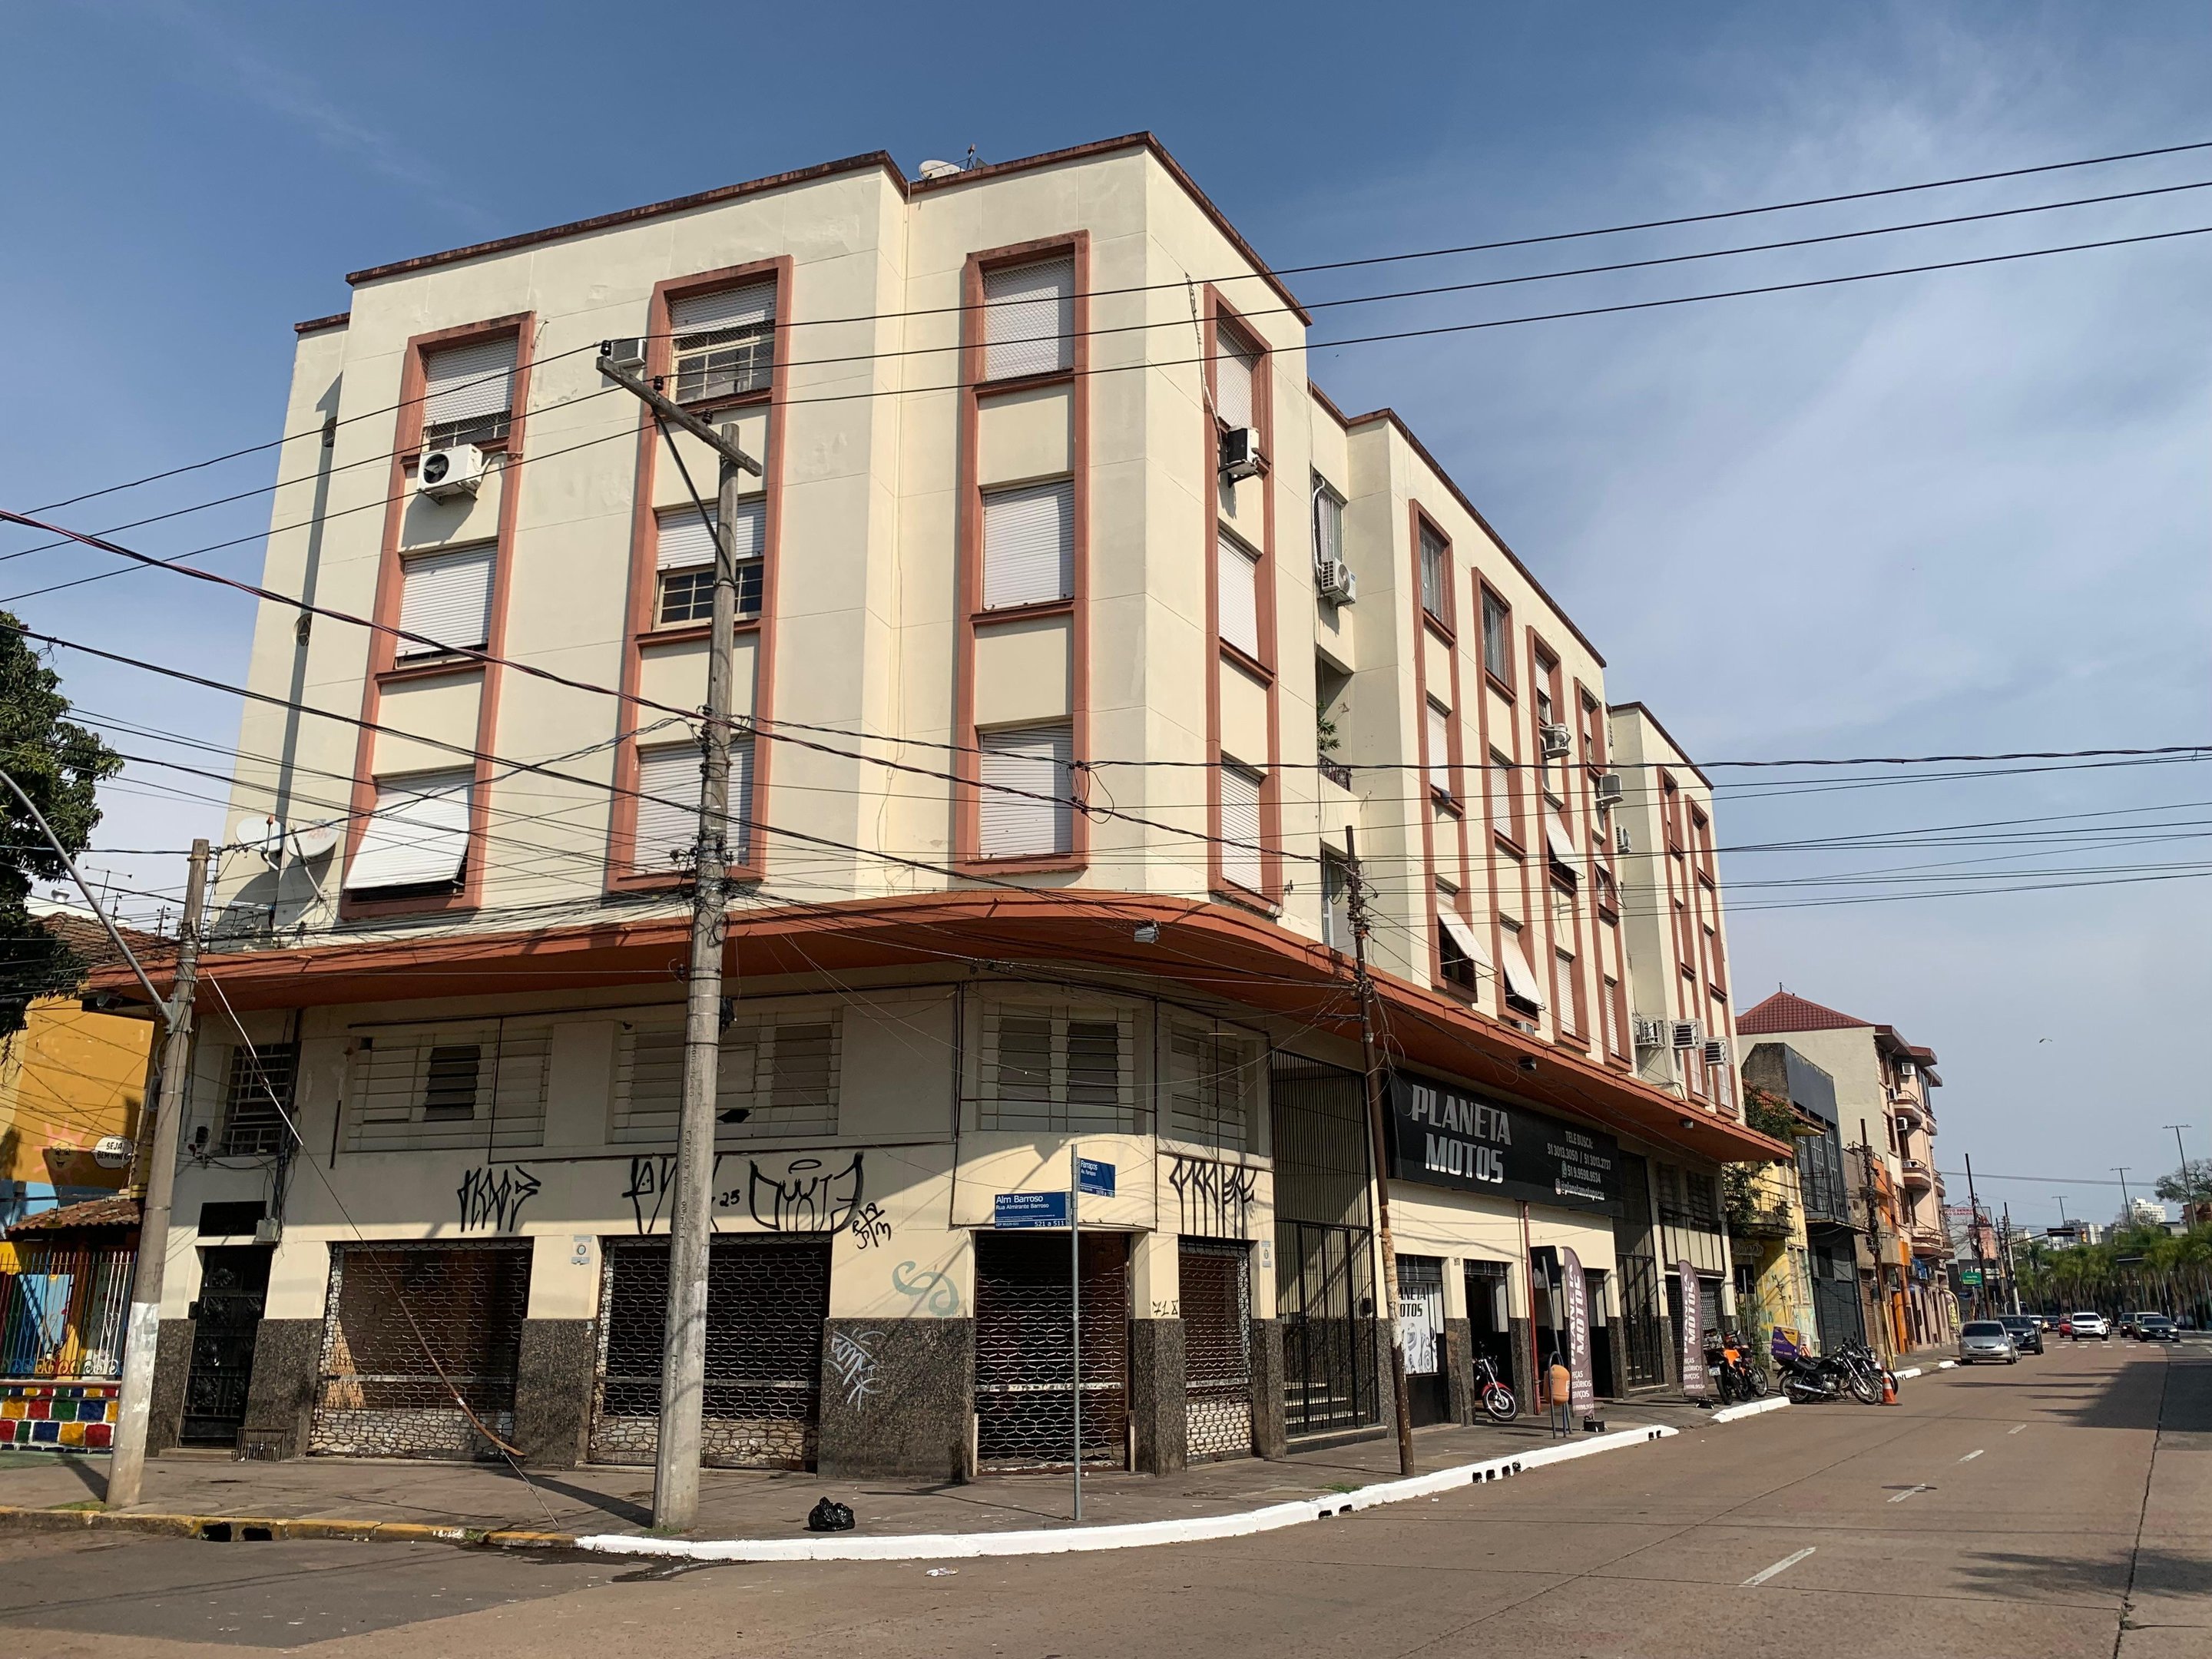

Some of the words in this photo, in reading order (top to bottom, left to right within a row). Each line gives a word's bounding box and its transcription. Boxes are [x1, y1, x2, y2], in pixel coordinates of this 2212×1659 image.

[1412, 1084, 1512, 1145] PLANETA
[1565, 1131, 1577, 1144] TELE
[106, 1141, 122, 1150] SEJA
[1426, 1133, 1503, 1184] MOTOS
[1547, 1142, 1553, 1155] 51
[1584, 1153, 1590, 1165] 51
[1081, 1160, 1098, 1171] Farrapos
[1398, 1286, 1426, 1300] ANETA
[1399, 1303, 1423, 1317] OTOS
